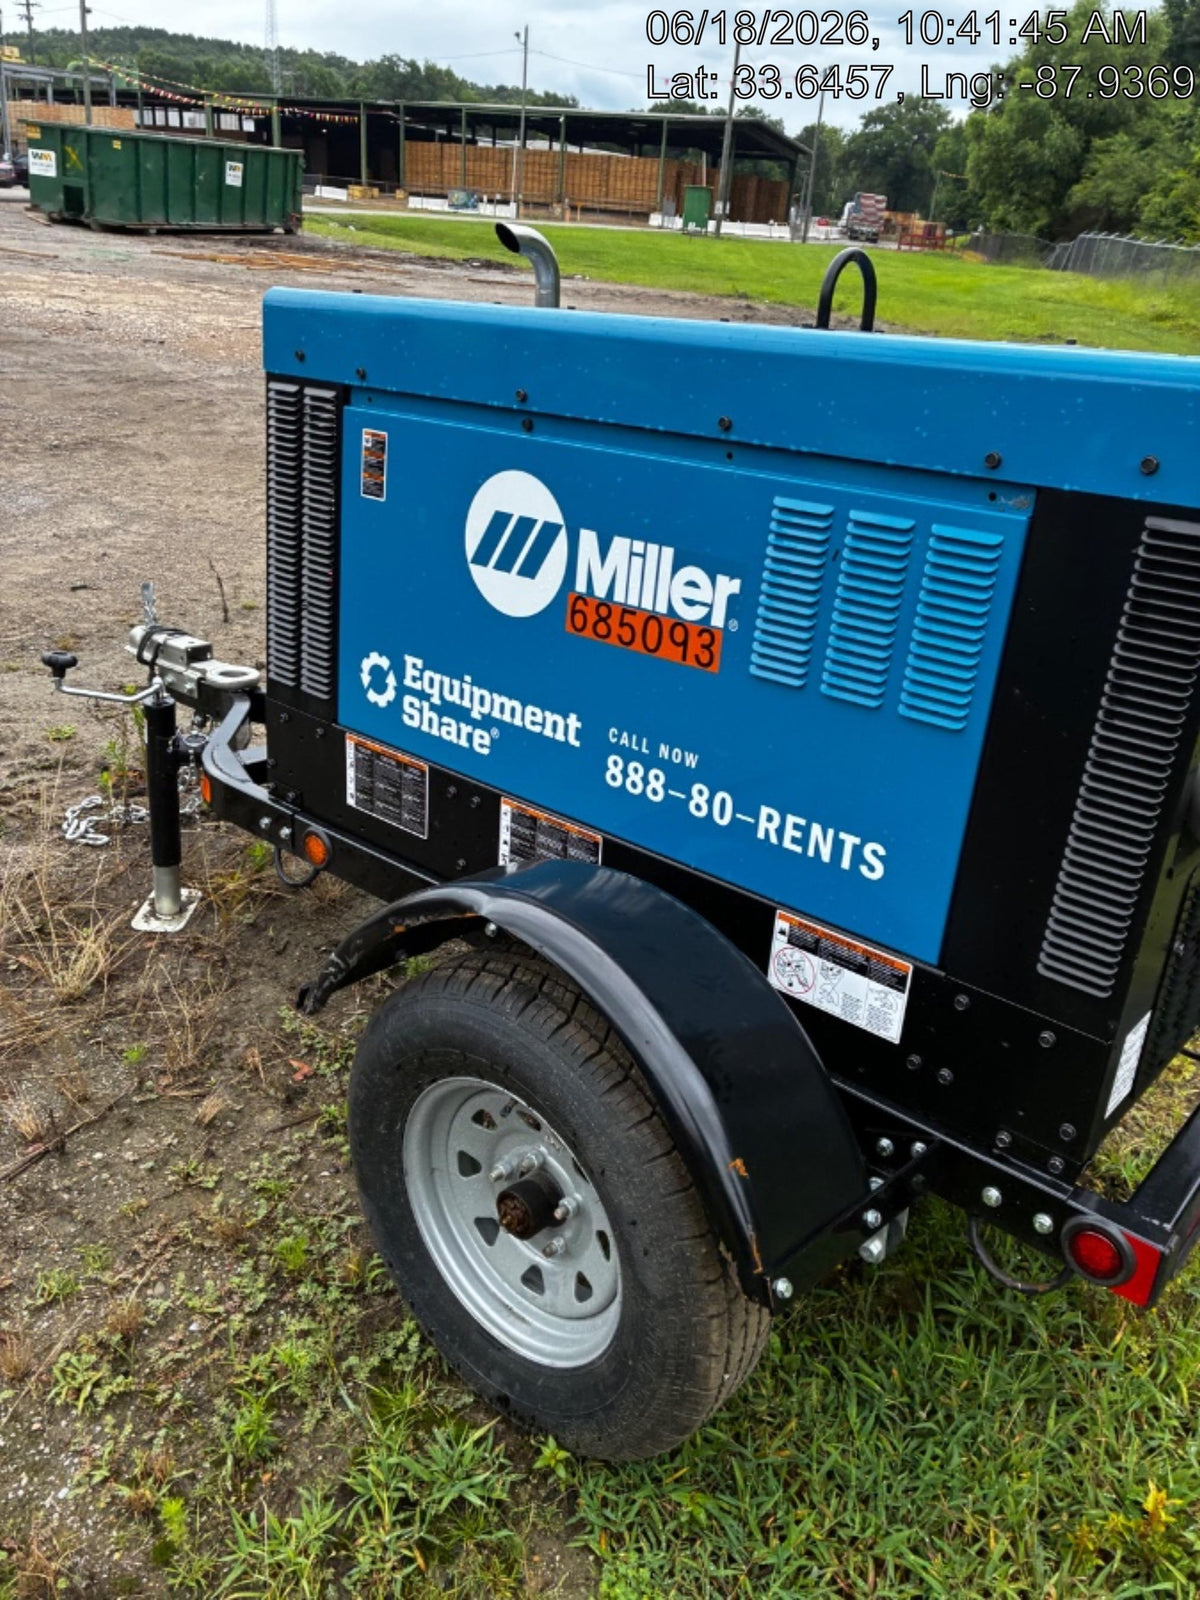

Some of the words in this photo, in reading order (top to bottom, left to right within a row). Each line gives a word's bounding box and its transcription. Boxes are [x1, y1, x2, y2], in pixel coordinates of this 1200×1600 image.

[575, 528, 742, 629] Miller
[569, 595, 716, 668] 685093
[403, 654, 582, 748] Equipment
[608, 727, 650, 755] CALL
[658, 742, 700, 769] NOW
